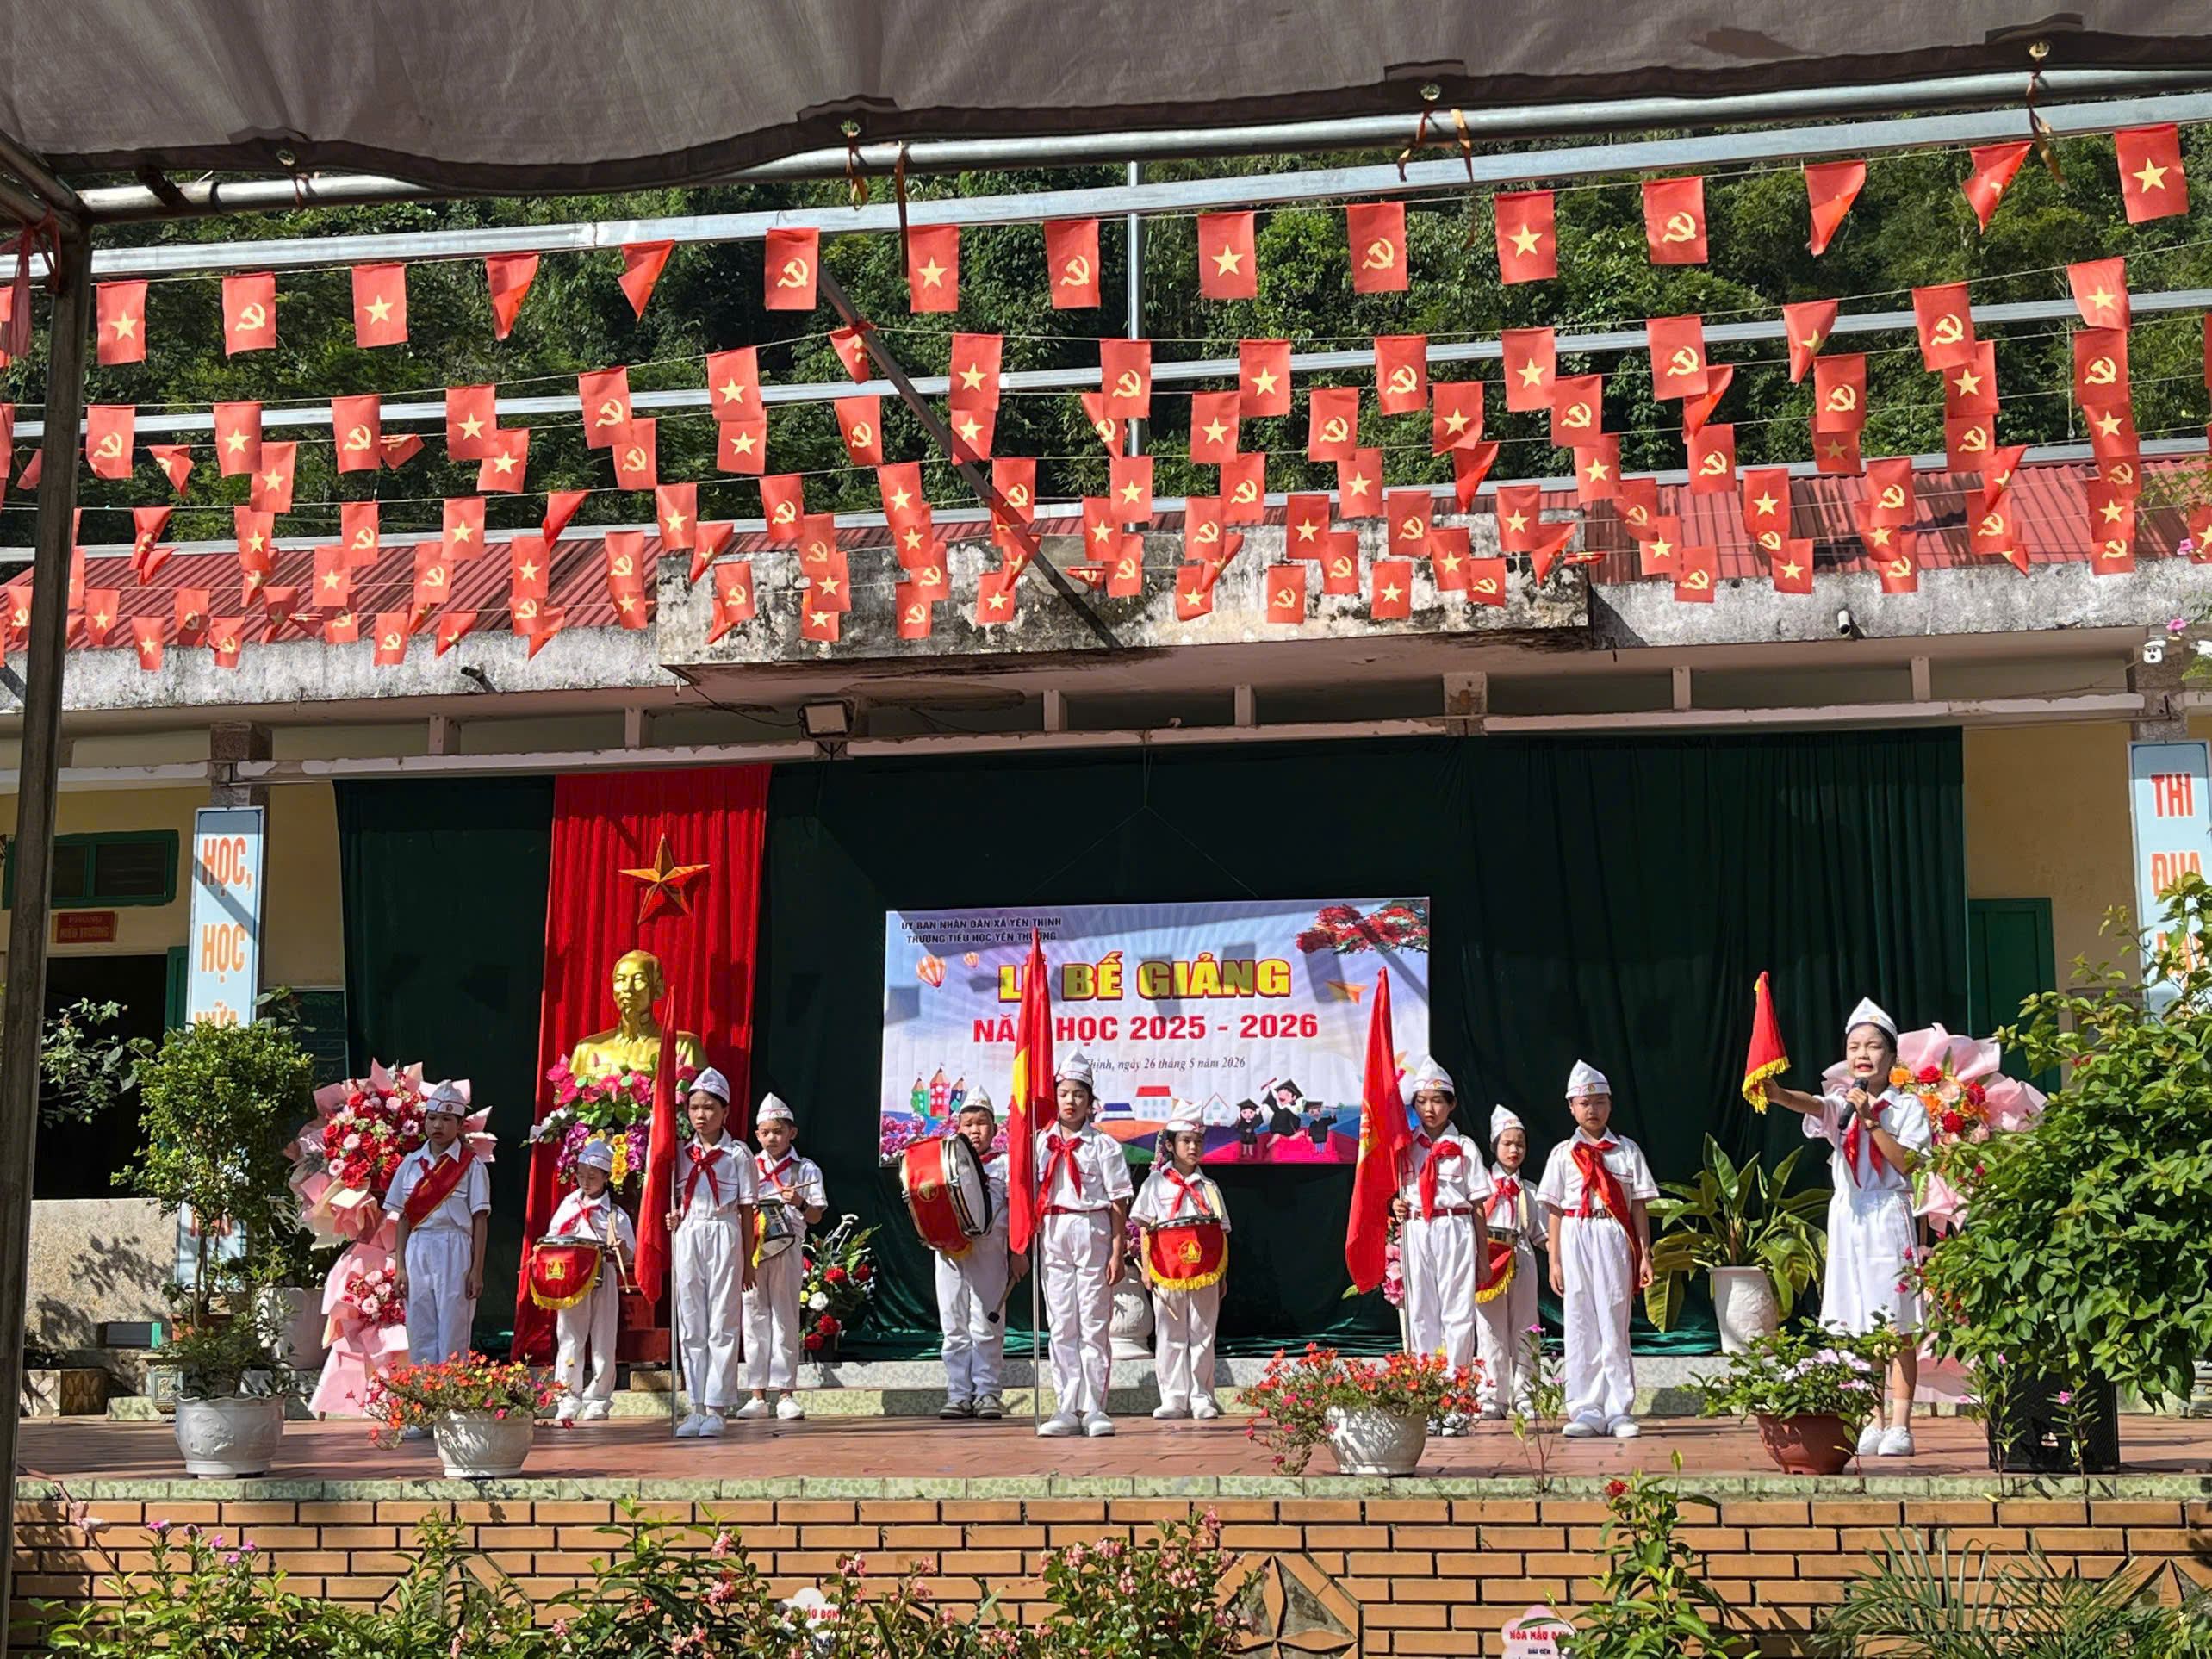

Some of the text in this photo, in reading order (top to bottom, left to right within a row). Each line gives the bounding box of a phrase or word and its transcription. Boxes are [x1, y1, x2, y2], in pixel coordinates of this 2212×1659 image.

[2151, 773, 2195, 817] THI
[202, 837, 252, 897] HỌC,
[916, 921, 936, 930] BAN
[940, 919, 966, 929] NHÂN
[970, 918, 991, 929] DÂN
[1010, 916, 1029, 928] YÊN
[972, 933, 991, 943] HỌC
[995, 931, 1014, 941] YÊN
[201, 923, 245, 983] HỌC
[1061, 950, 1123, 1002] BẾ
[1136, 952, 1291, 1000] GIẢNG
[973, 1014, 1020, 1042] NĂ
[1056, 1016, 1118, 1047] HỌC
[1129, 1015, 1206, 1040] 2025
[1240, 1014, 1318, 1038] 2026
[1117, 1058, 1140, 1072] ngày
[1144, 1058, 1156, 1069] 26
[1158, 1058, 1186, 1072] tháng
[1189, 1058, 1196, 1069] 5
[1197, 1059, 1219, 1069] năm
[1221, 1057, 1246, 1068] 2026
